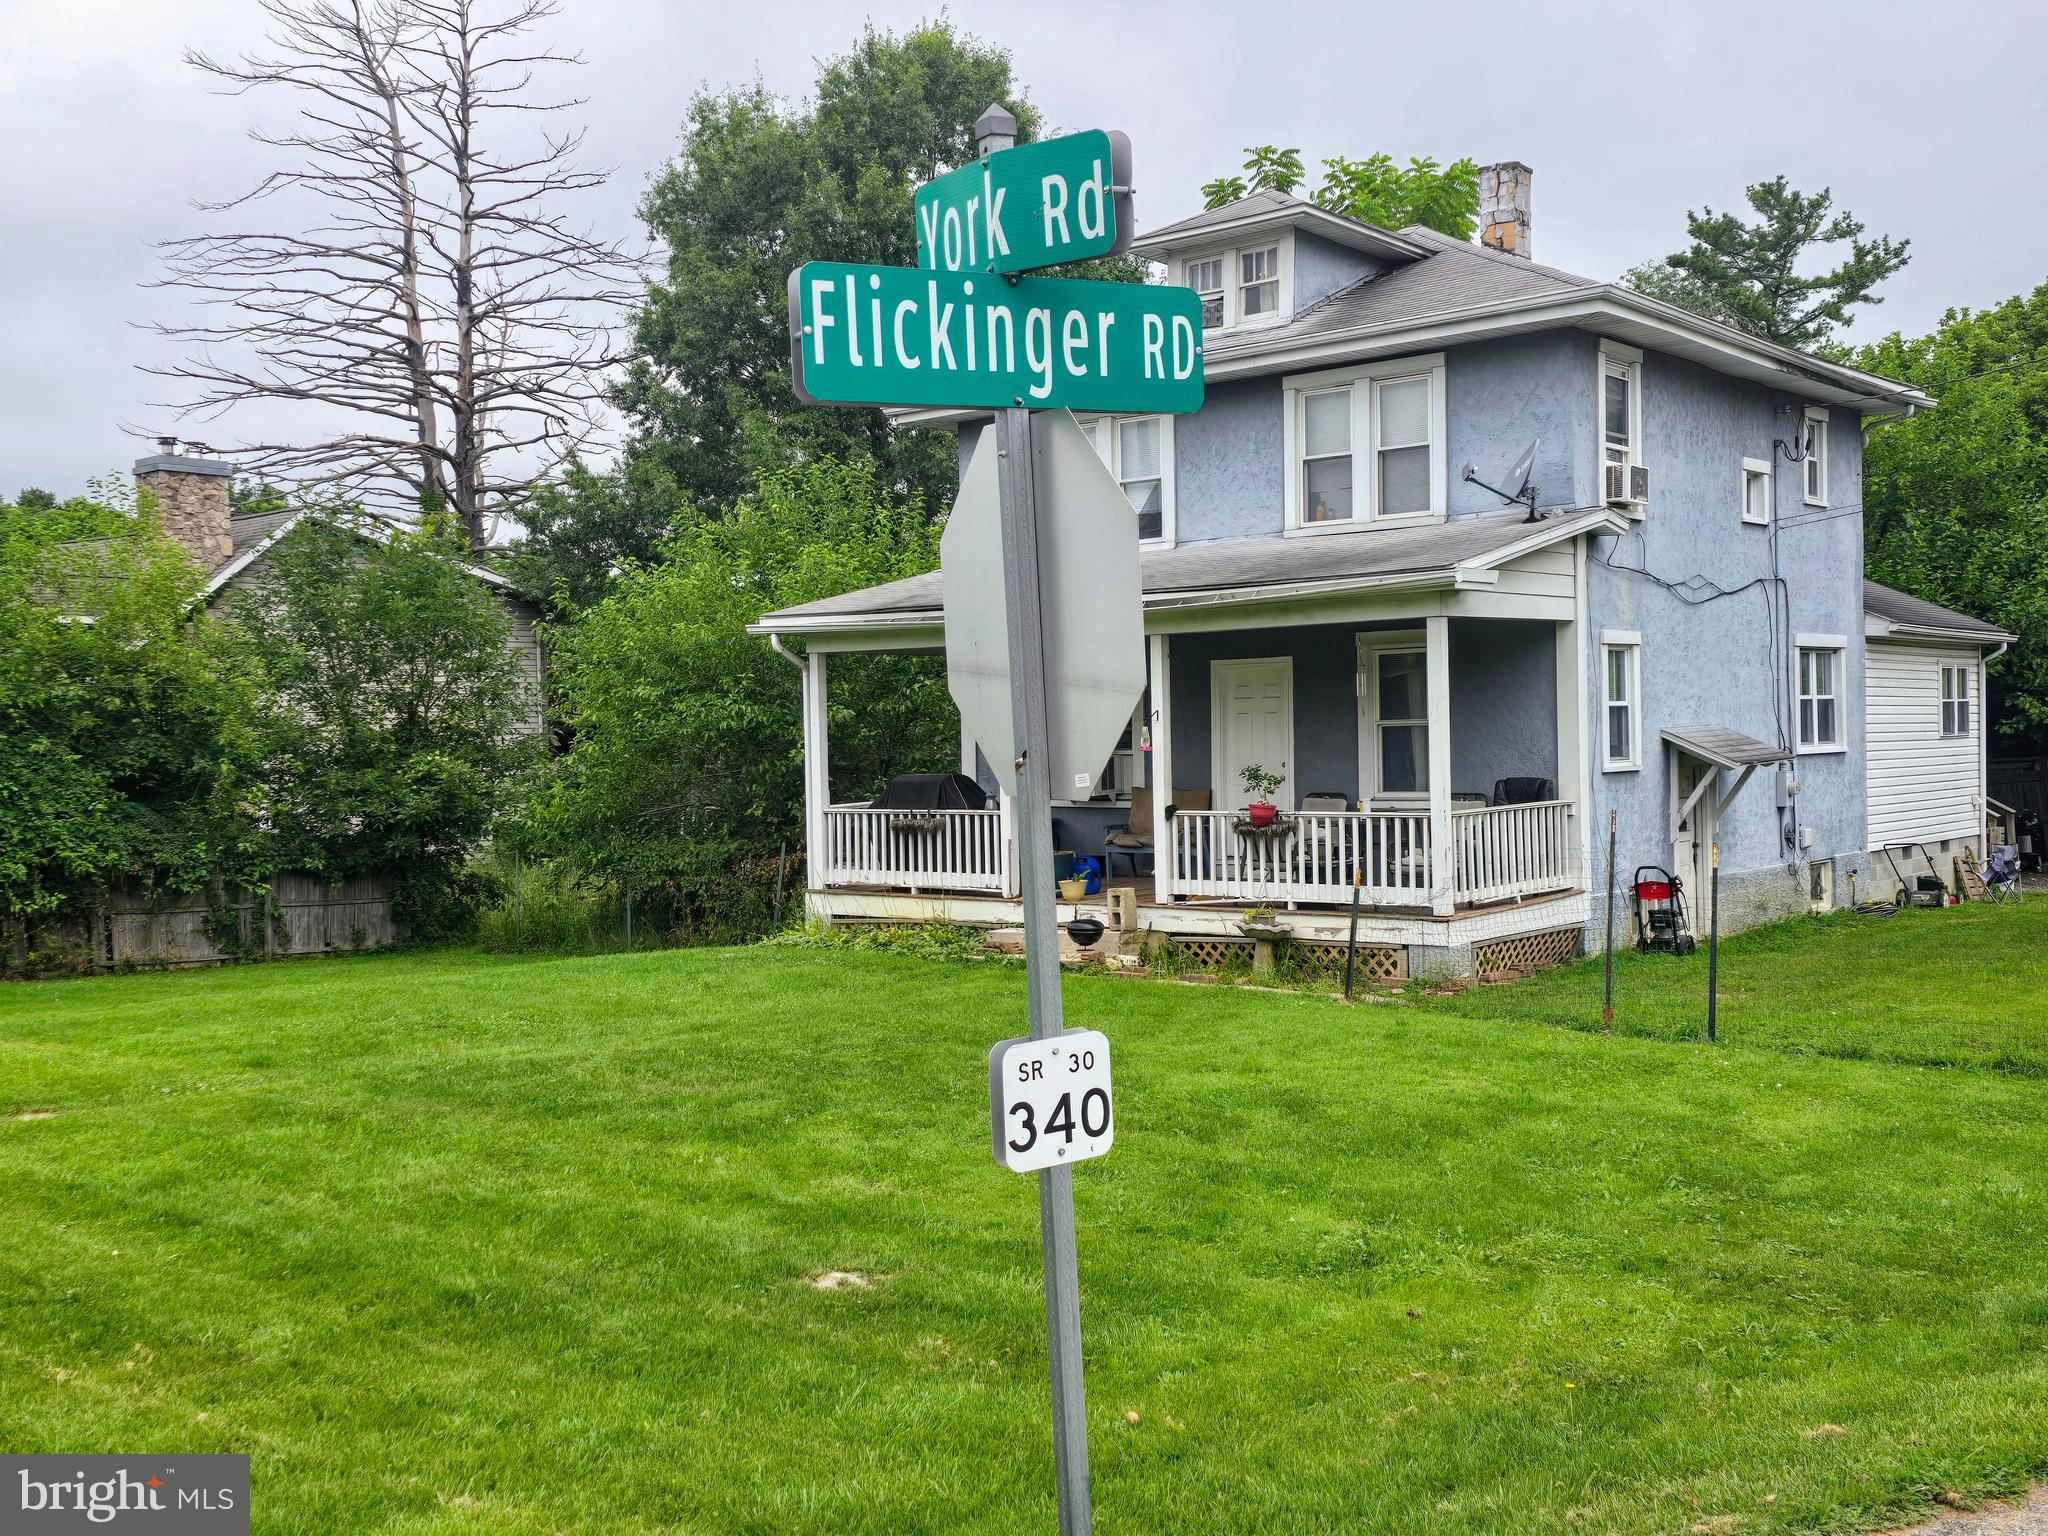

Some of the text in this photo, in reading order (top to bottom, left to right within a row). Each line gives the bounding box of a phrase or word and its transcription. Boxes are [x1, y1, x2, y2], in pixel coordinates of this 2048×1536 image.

[920, 159, 1105, 271] York Rd
[811, 274, 1195, 399] Flickinger RD
[1018, 1050, 1095, 1082] SR 30
[1008, 1087, 1110, 1153] 340
